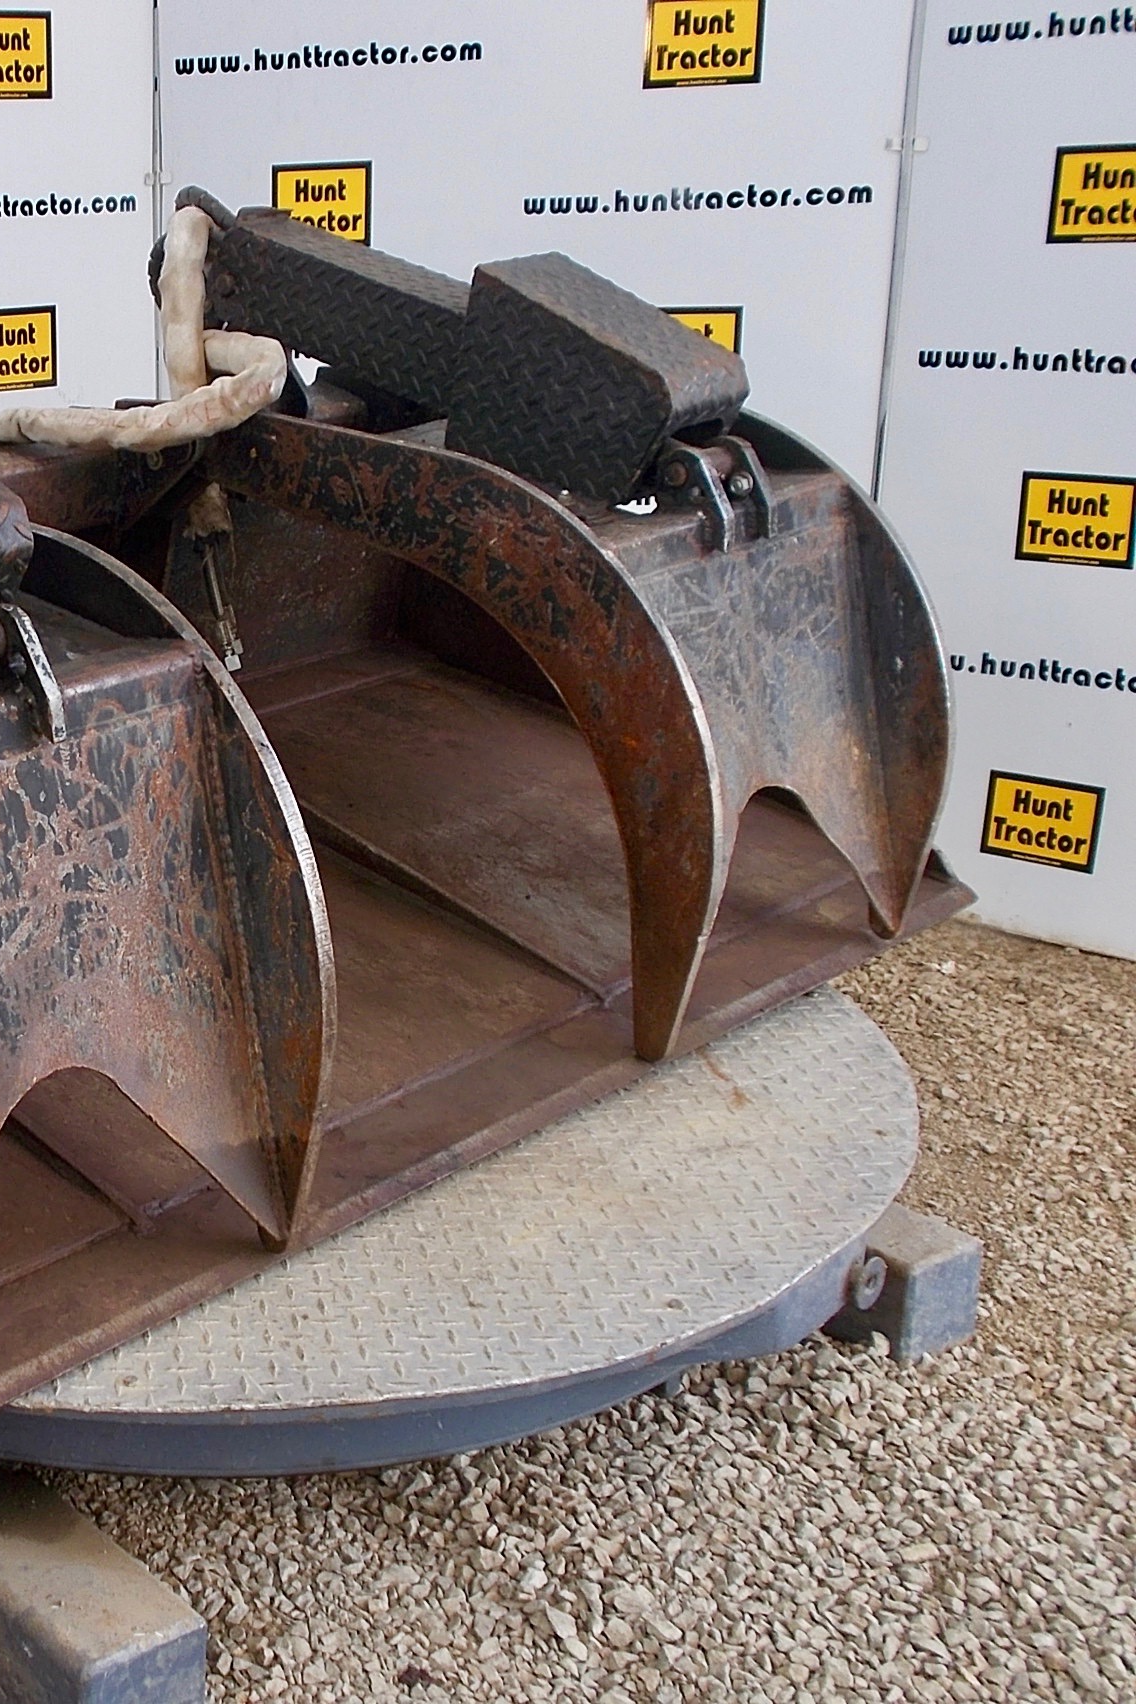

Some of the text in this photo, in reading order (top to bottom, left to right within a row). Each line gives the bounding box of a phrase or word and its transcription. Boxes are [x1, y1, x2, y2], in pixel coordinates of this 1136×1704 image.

[673, 10, 735, 36] Hunt
[947, 8, 1136, 45] www.huntt
[175, 40, 482, 75] www.hunttractor.com
[656, 44, 752, 70] Tractor
[295, 179, 346, 202] Hunt
[523, 182, 873, 214] www.hunttractor.com
[1060, 199, 1136, 225] Tract
[1048, 489, 1110, 517] Hunt
[1027, 520, 1126, 552] Tractor
[1012, 789, 1074, 821] Hunt
[993, 816, 1088, 855] Tractor
